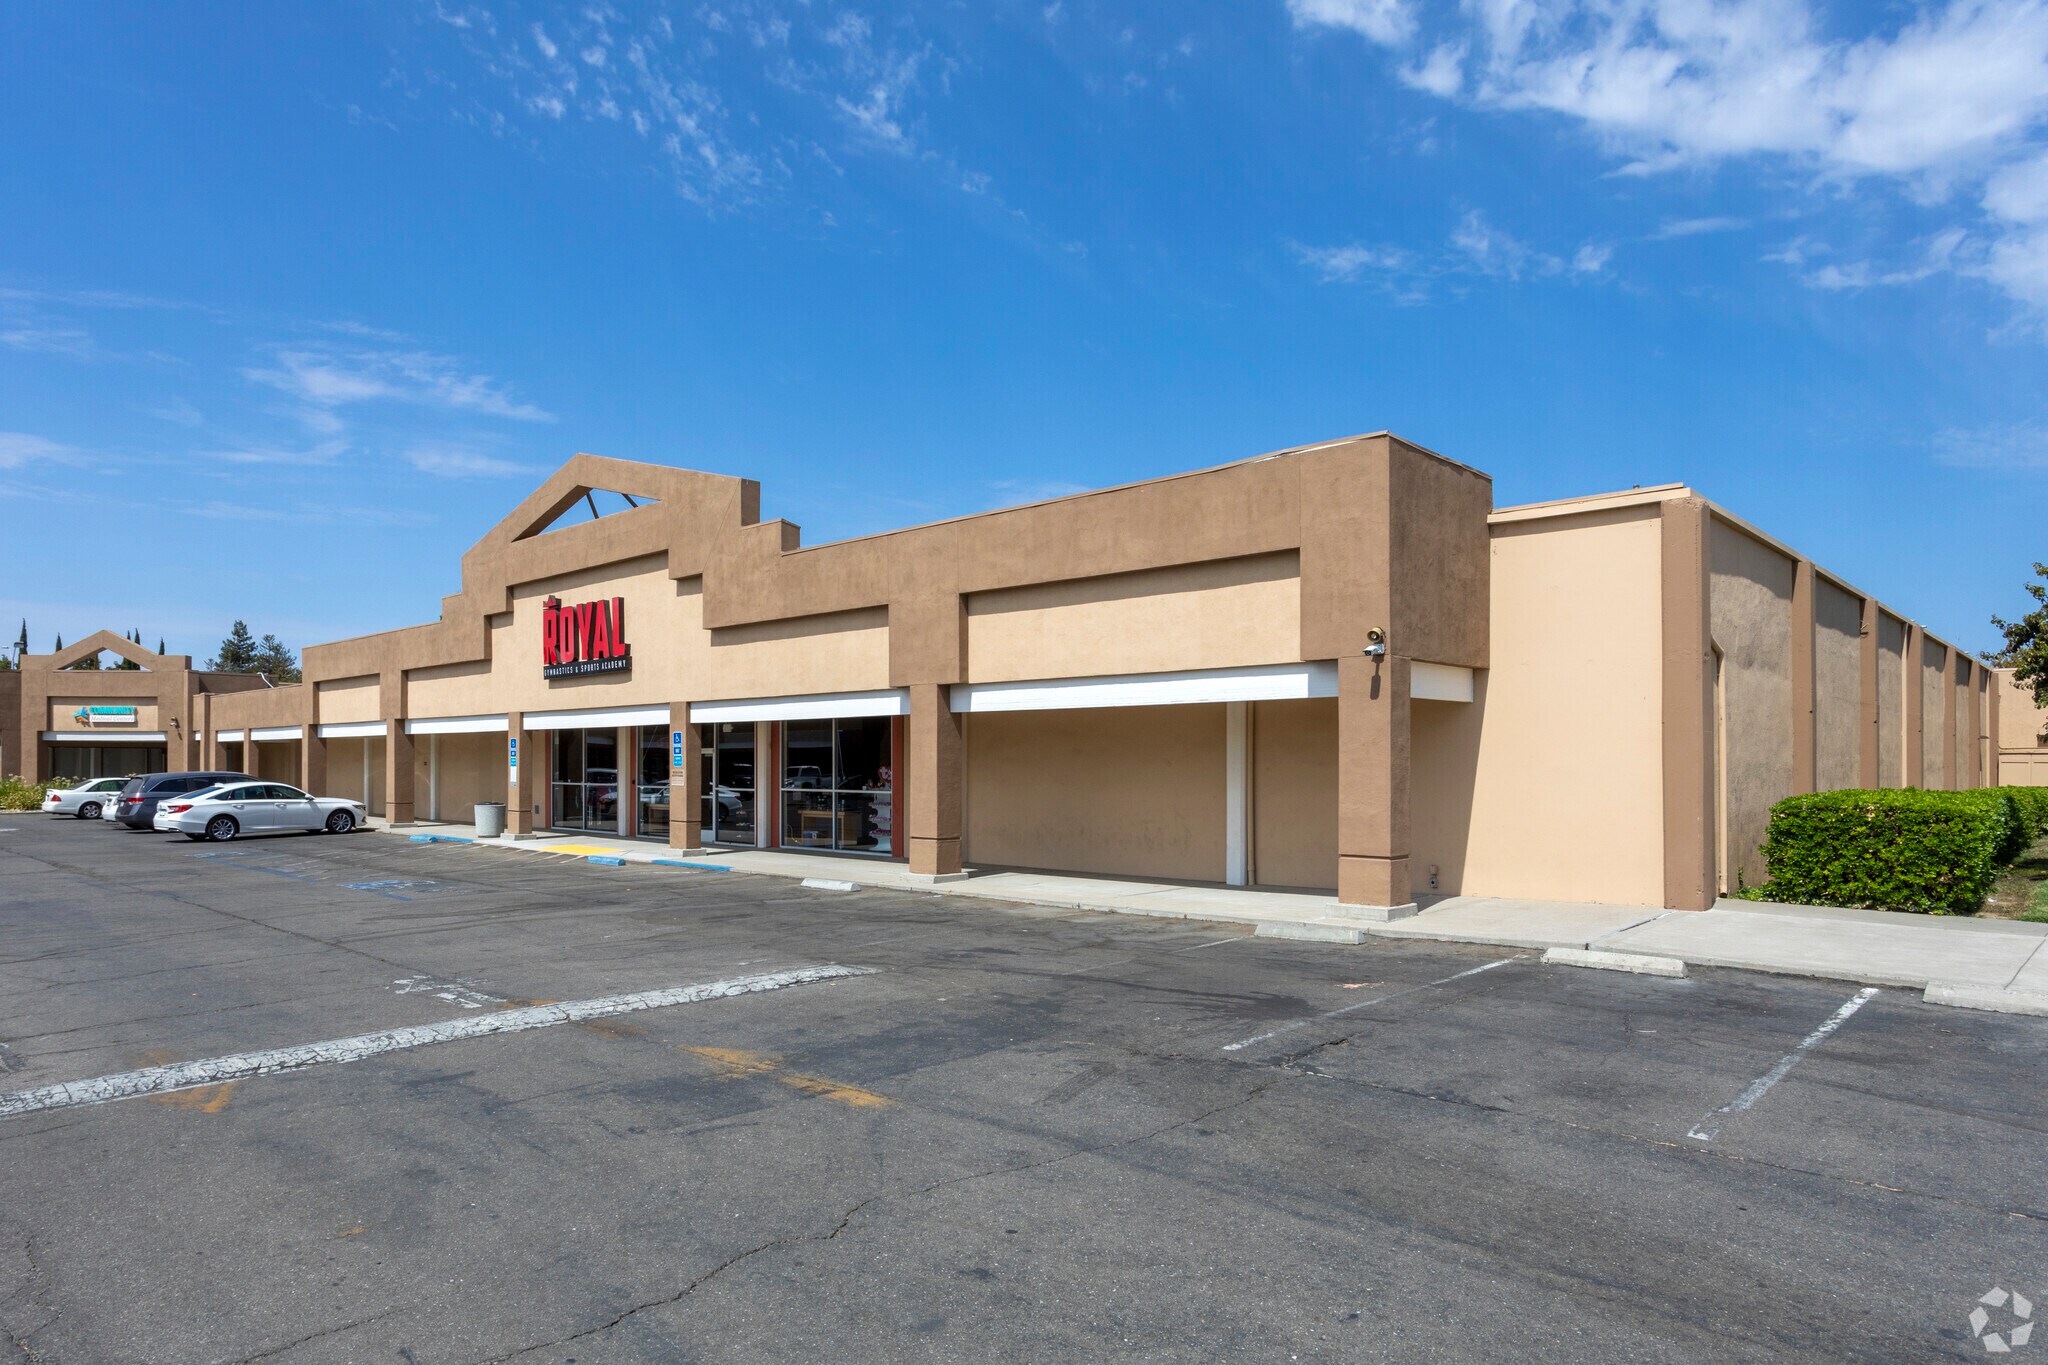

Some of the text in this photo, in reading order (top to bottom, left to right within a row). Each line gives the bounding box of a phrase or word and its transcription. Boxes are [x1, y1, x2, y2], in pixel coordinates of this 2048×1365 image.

[543, 597, 627, 665] ROYAL
[580, 663, 600, 673] SPORTS
[601, 660, 626, 670] ACADEMY
[89, 705, 135, 715] COMMUNITY
